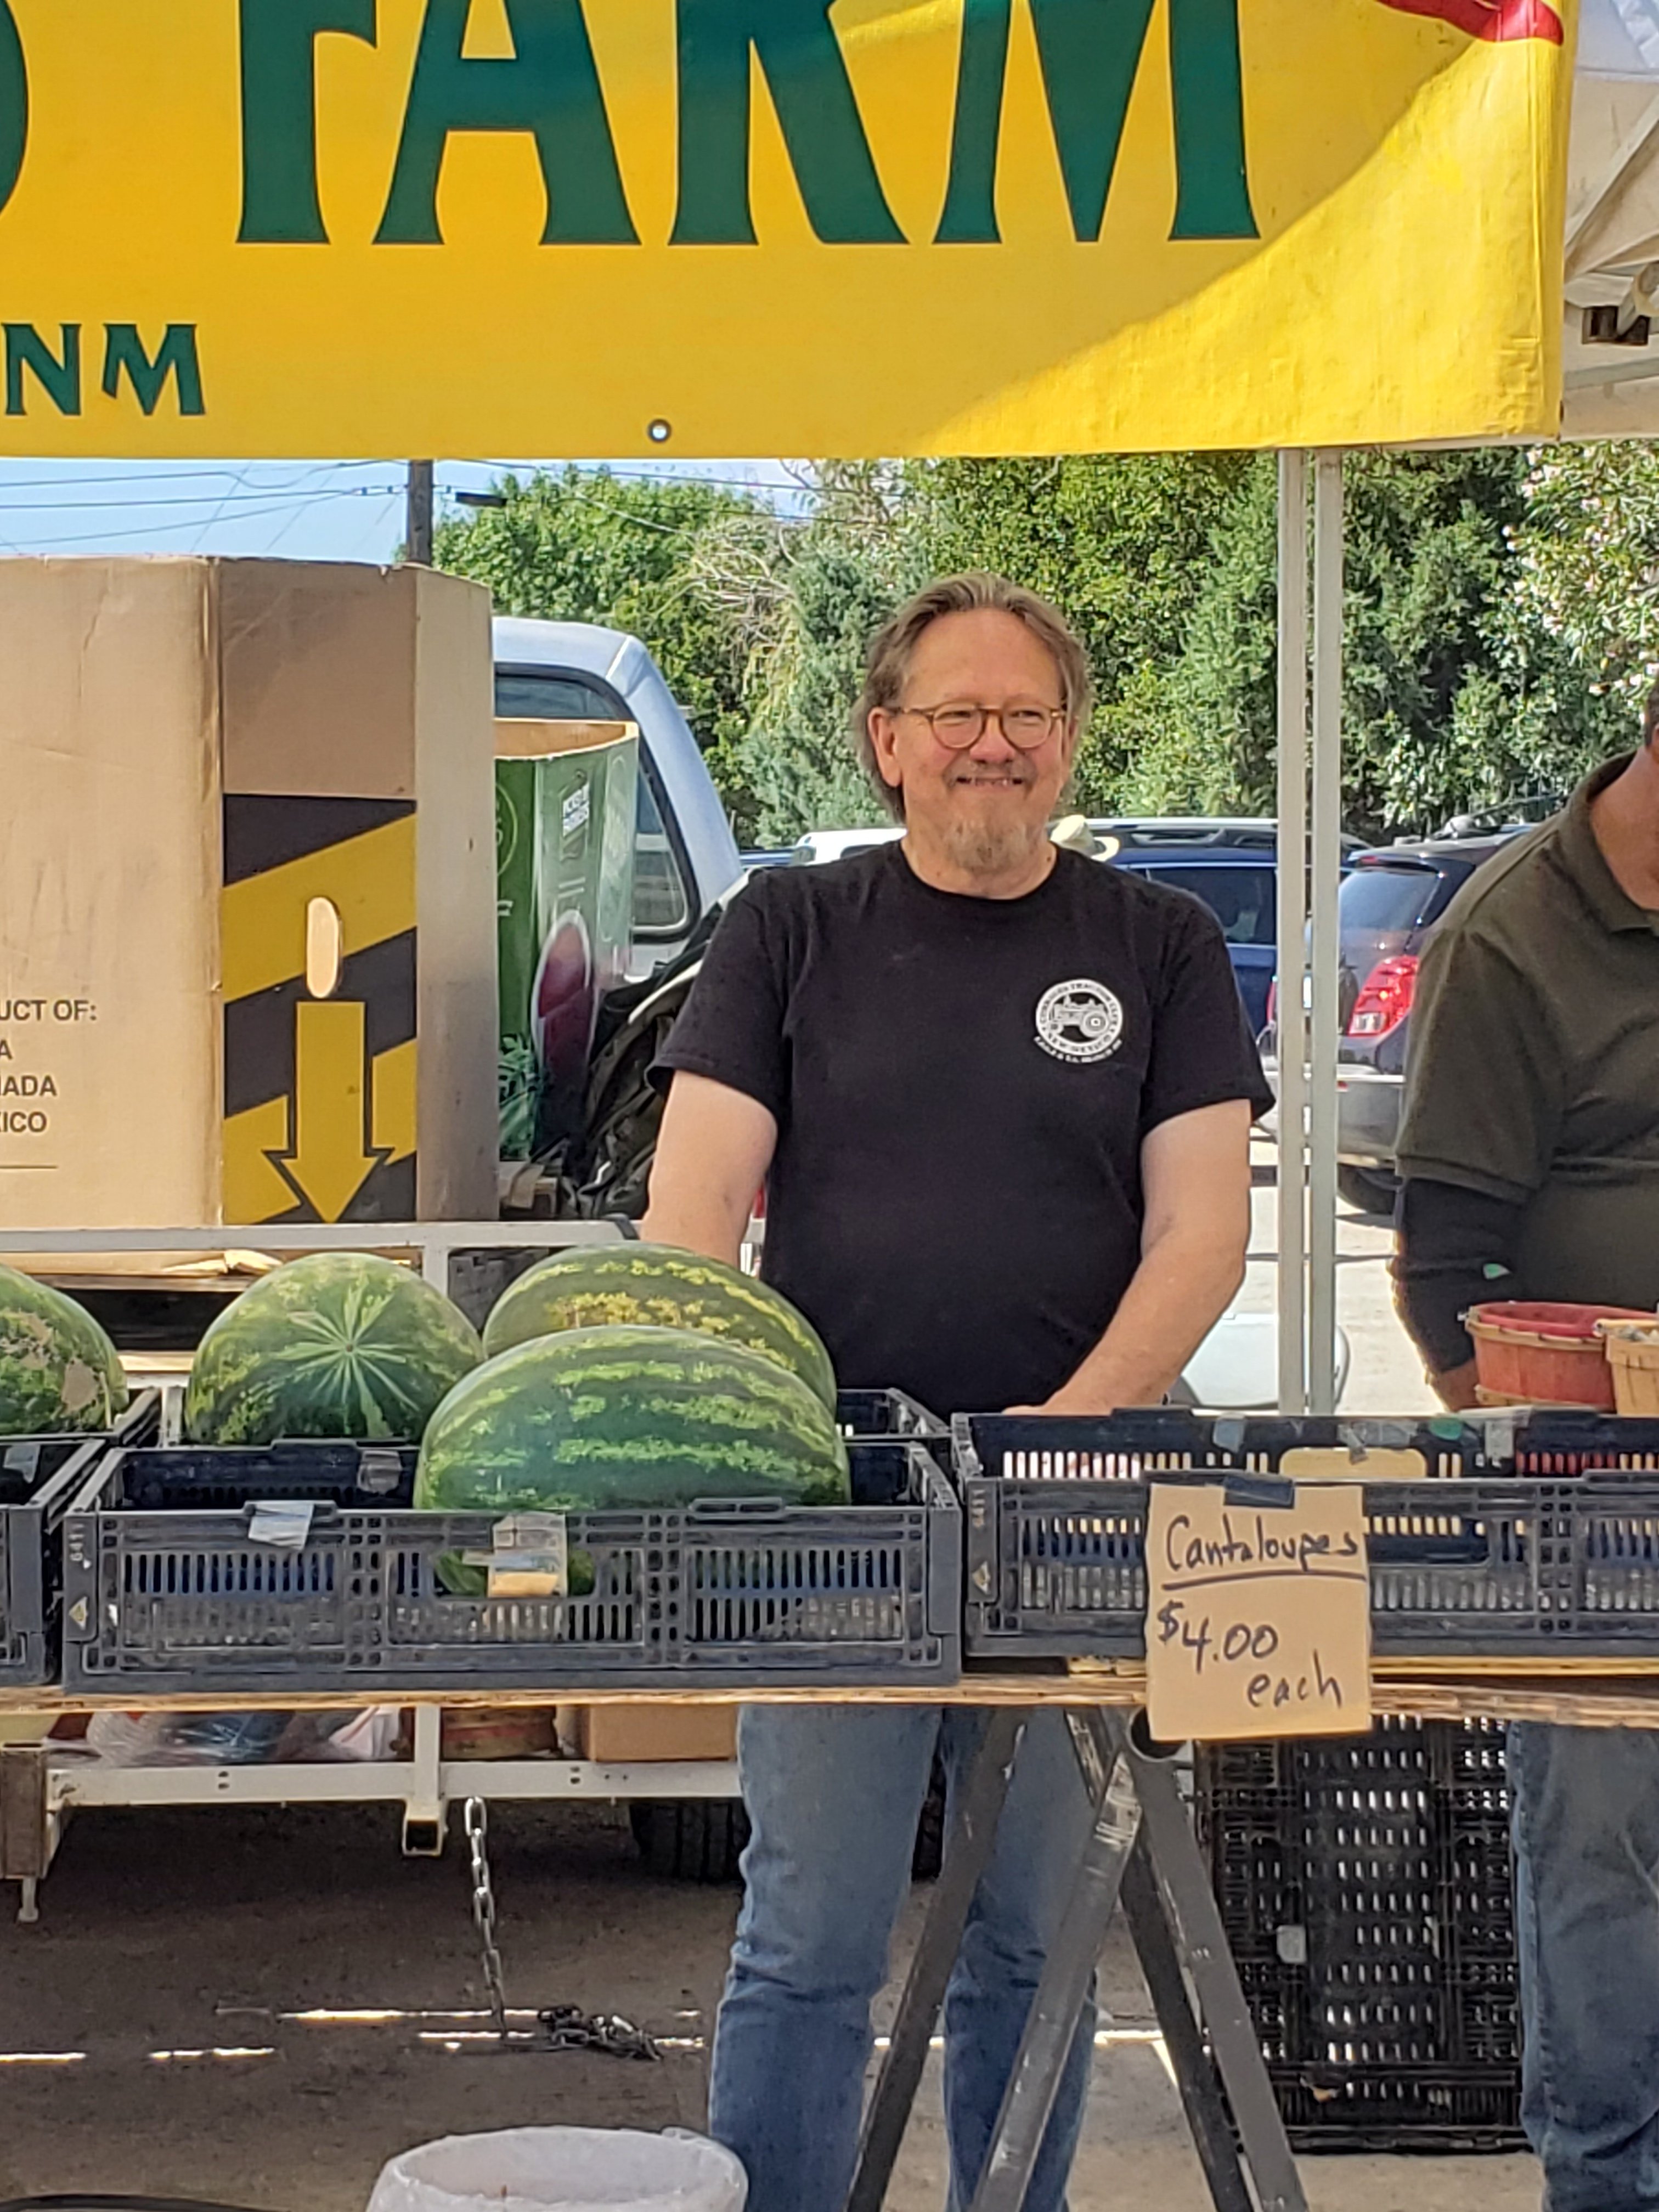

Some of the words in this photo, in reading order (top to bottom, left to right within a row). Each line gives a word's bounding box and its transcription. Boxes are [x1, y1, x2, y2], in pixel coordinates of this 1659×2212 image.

[235, 0, 1261, 245] FARM
[1, 323, 206, 415] NM
[53, 1000, 97, 1021] OF:
[0, 1075, 57, 1096] ADA
[0, 1111, 47, 1132] ICO
[1166, 1513, 1358, 1571] Cantaloupes
[1157, 1599, 1278, 1674] $4.00
[1248, 1649, 1342, 1708] each
